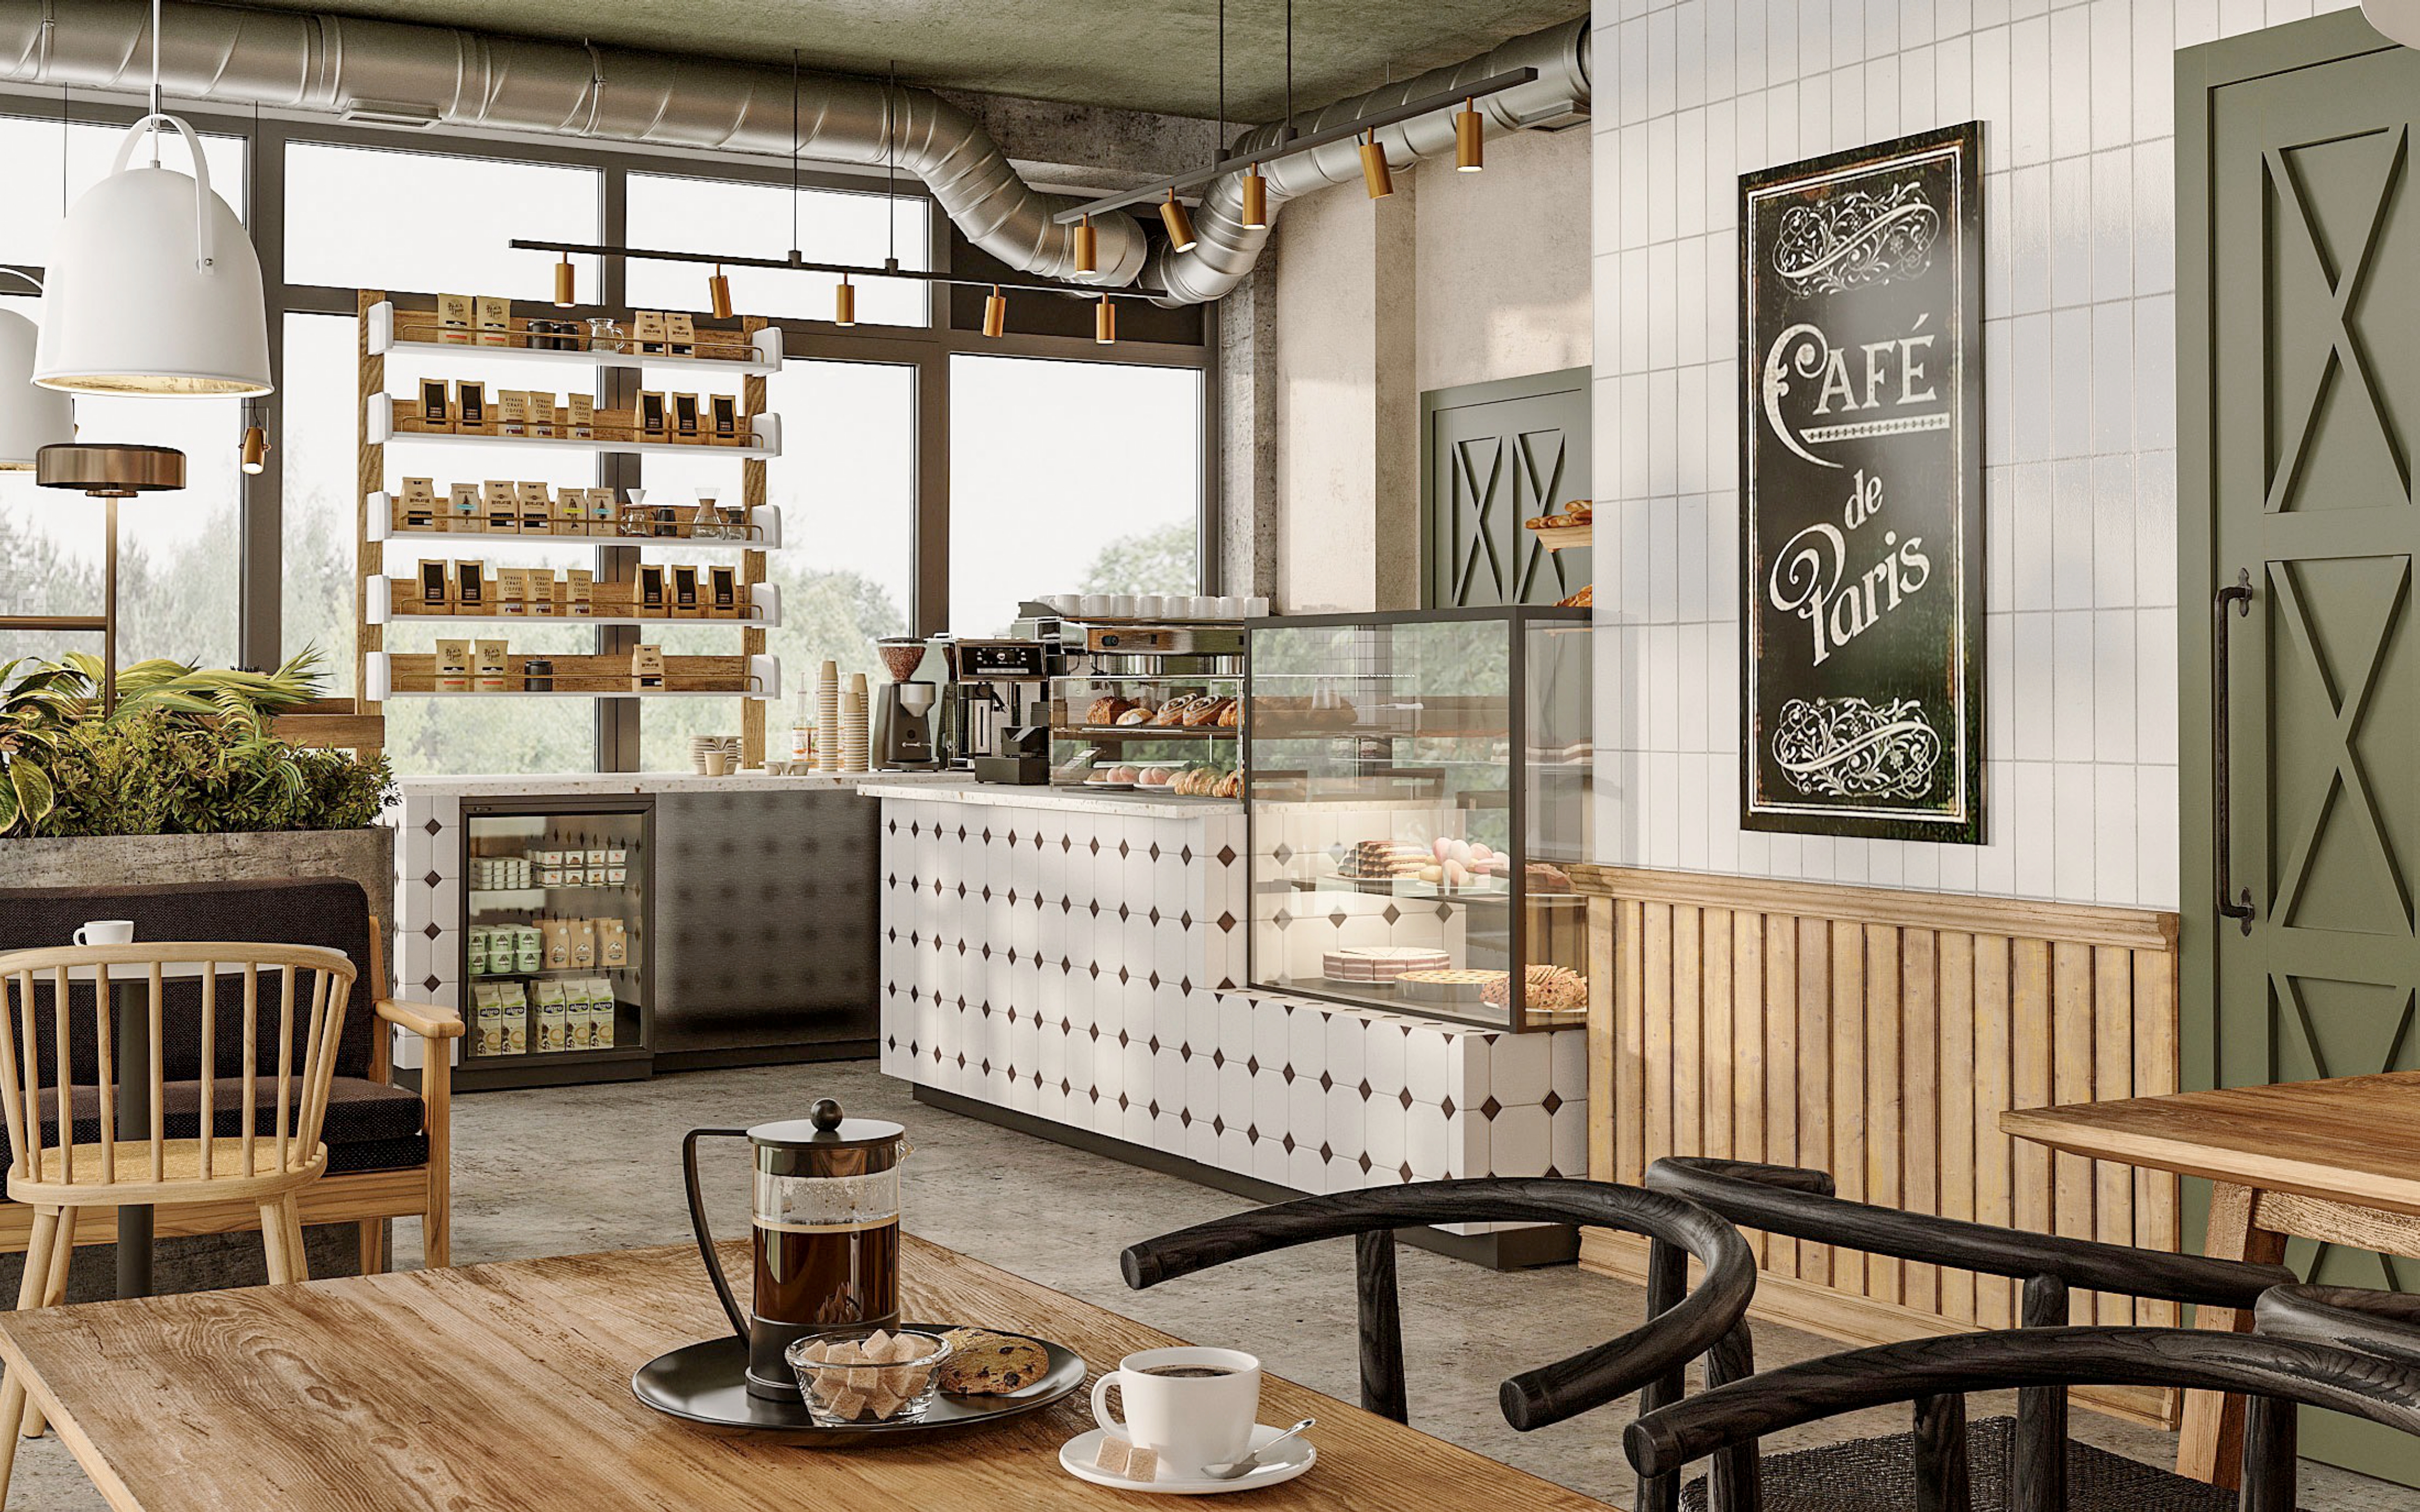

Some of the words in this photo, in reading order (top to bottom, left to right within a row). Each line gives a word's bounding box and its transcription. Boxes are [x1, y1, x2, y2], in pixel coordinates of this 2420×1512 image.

[1762, 313, 1937, 469] CAFÉ
[1845, 469, 1884, 530] de
[1770, 522, 1931, 667] Paris
[506, 1006, 524, 1016] alpro
[545, 1004, 562, 1013] alpro
[570, 1003, 588, 1012] alpro
[594, 1002, 611, 1011] alpro
[481, 1007, 499, 1017] alpro
